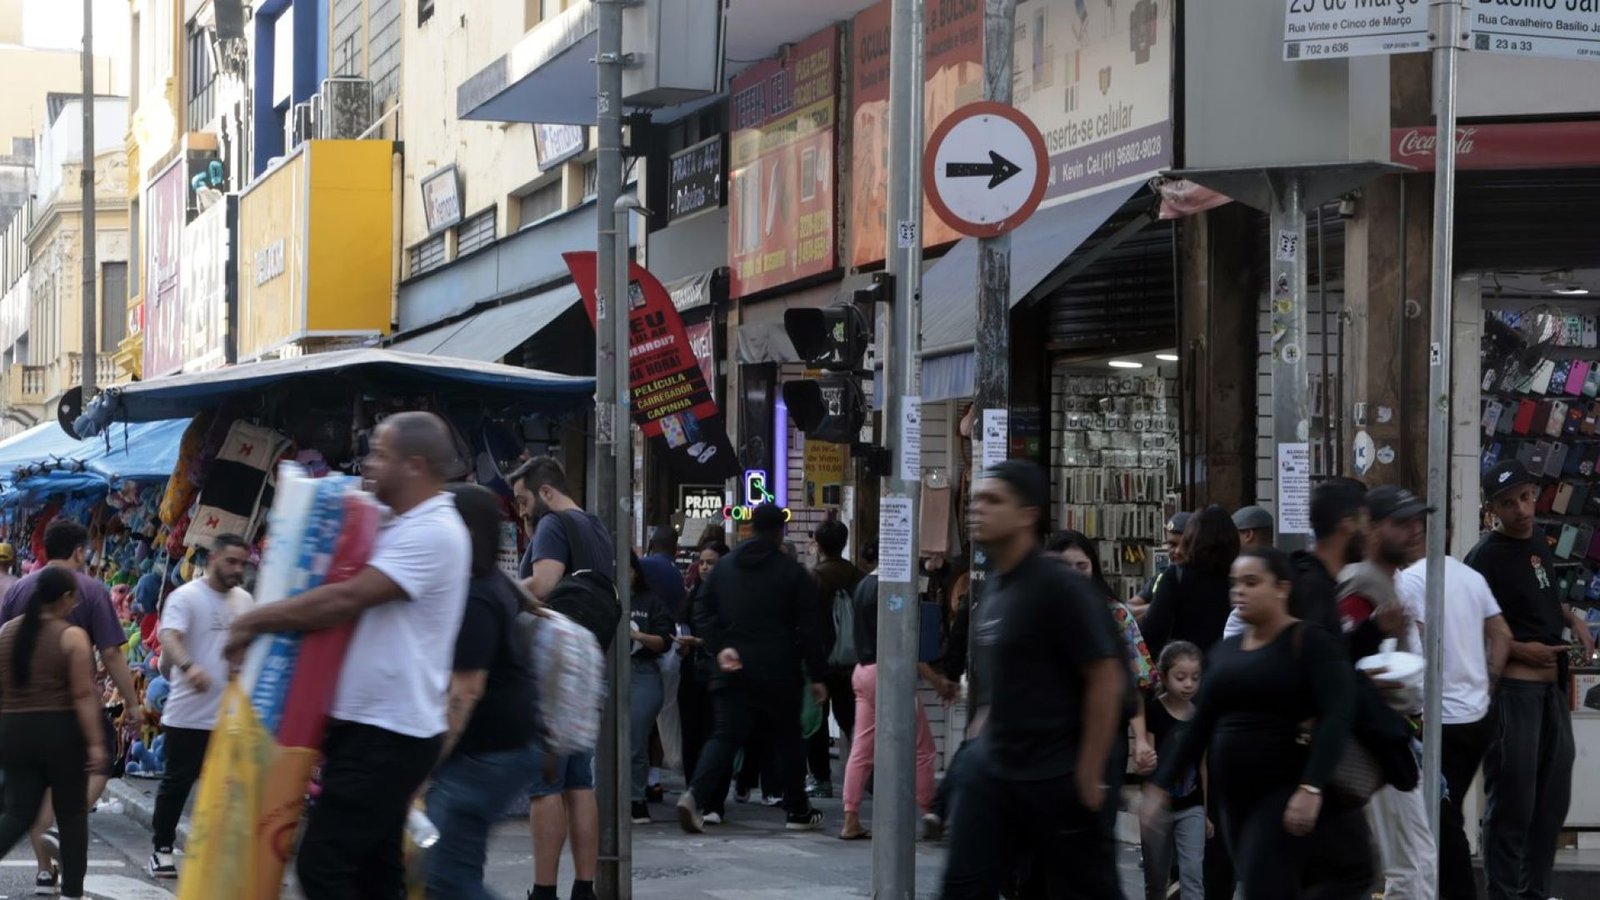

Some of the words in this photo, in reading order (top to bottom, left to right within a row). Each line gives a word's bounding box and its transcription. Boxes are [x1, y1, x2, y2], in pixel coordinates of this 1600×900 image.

[1288, 23, 1306, 33] Rua
[1308, 21, 1329, 32] Vinte
[1340, 19, 1367, 29] Cinco
[1369, 18, 1381, 27] de
[1383, 16, 1411, 27] Março
[1478, 13, 1498, 25] Rua
[1500, 15, 1553, 29] Cavalheiro
[1556, 20, 1589, 32] Basílio
[860, 23, 891, 64] OCULO
[1305, 44, 1322, 55] 702
[1332, 43, 1349, 53] 636
[1496, 39, 1509, 49] 23
[1510, 41, 1518, 50] a
[1520, 41, 1532, 51] 33
[1042, 119, 1093, 152] nserta-se
[1095, 101, 1134, 136] celular
[1399, 127, 1478, 157] Cocala
[1062, 160, 1084, 182] Kevin
[1117, 135, 1162, 167] 96802-9028
[630, 310, 665, 332] EU
[630, 335, 675, 357] EBROU?
[634, 372, 686, 397] PELÍCULA
[637, 383, 693, 409] CARREGADOR
[647, 398, 692, 420] CAPINHA
[685, 495, 722, 509] PRATA
